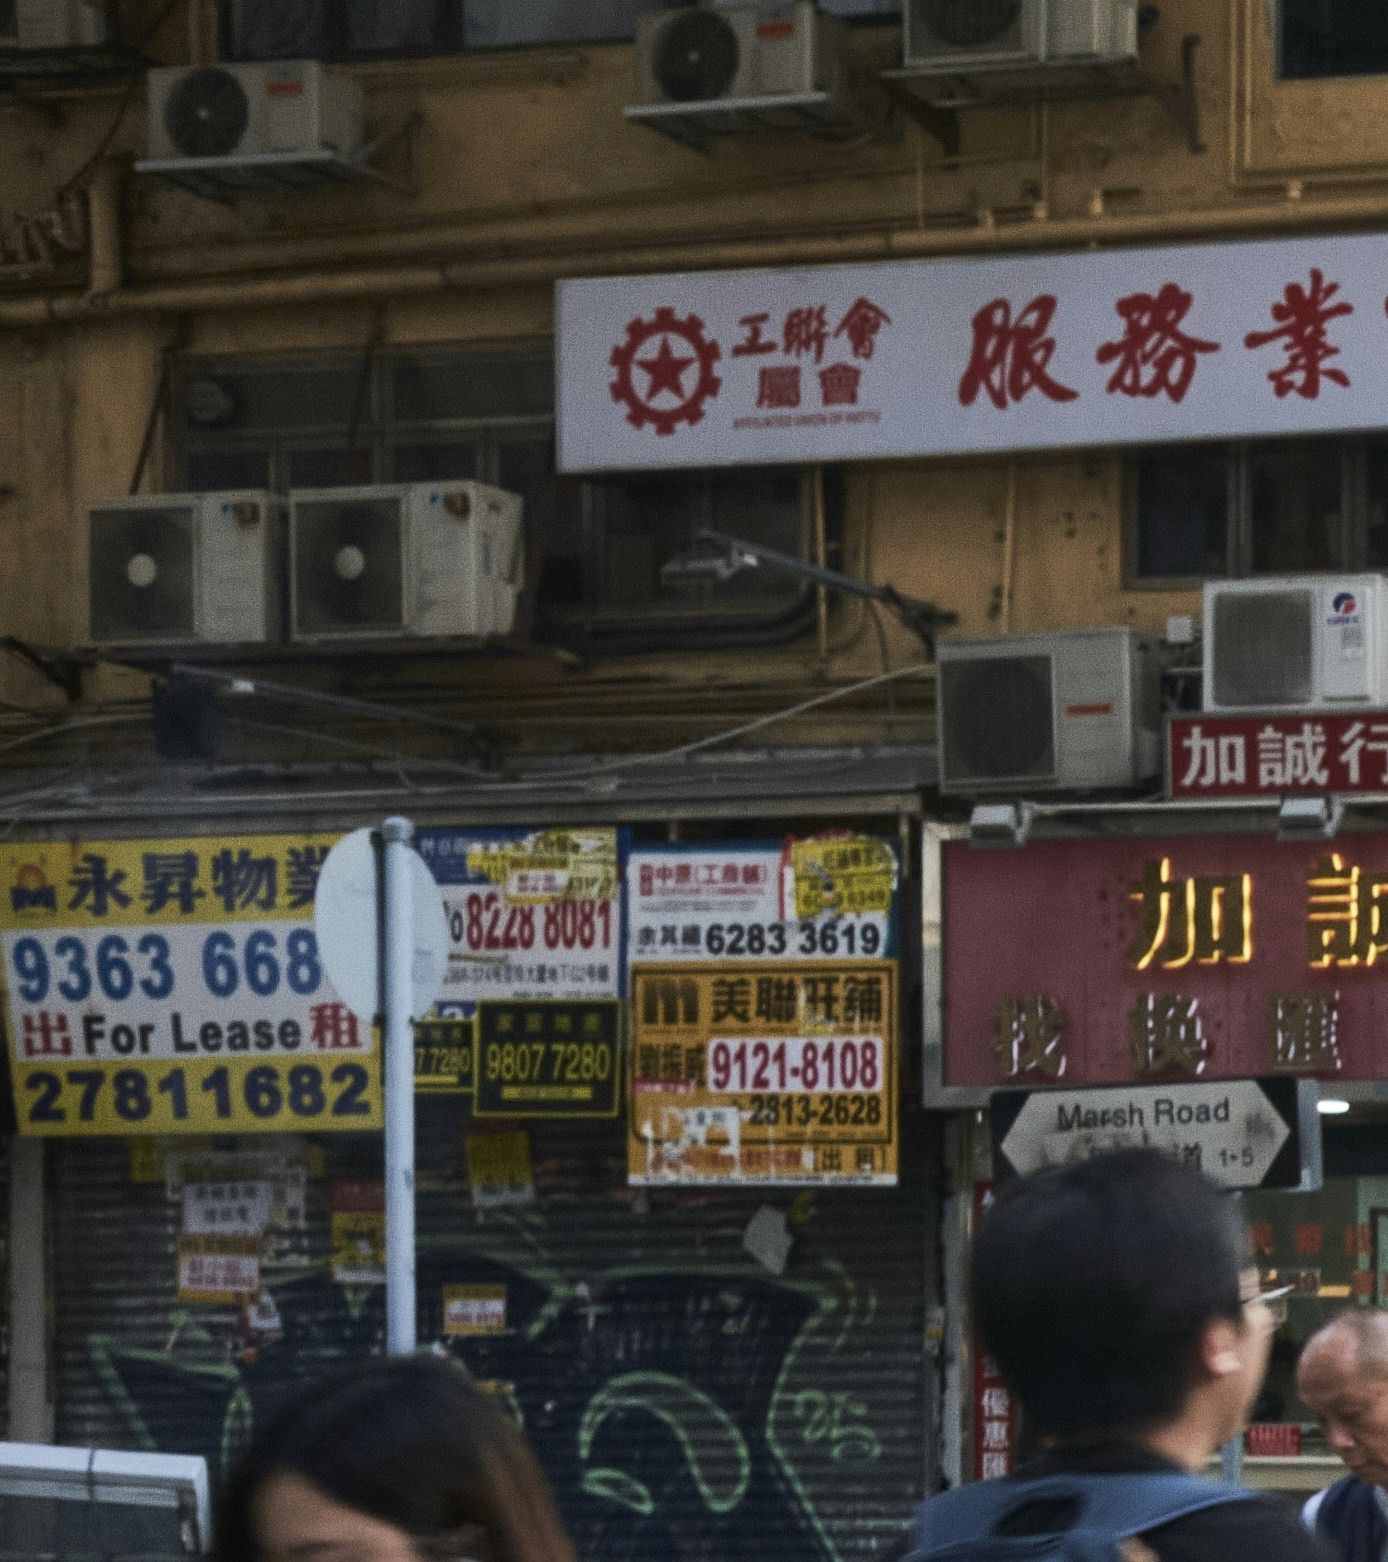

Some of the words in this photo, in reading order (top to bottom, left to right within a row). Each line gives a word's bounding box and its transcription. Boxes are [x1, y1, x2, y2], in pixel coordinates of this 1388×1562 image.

[731, 296, 892, 364] 工聯會
[67, 845, 332, 918] 永昇物業
[705, 922, 787, 955] 6283
[799, 921, 881, 955] 3619
[11, 933, 175, 1003] 9363
[201, 927, 323, 998] 668
[22, 1010, 73, 1057] 出
[81, 1012, 155, 1057] For
[170, 1012, 301, 1054] Lease
[310, 1001, 364, 1050] 租
[485, 1042, 546, 1082] 9807
[551, 1041, 611, 1081] 7280
[711, 1041, 879, 1090] 9121-8108
[25, 1062, 372, 1123] 27811682
[1057, 1102, 1144, 1132] Marsh
[1153, 1095, 1231, 1126] Road
